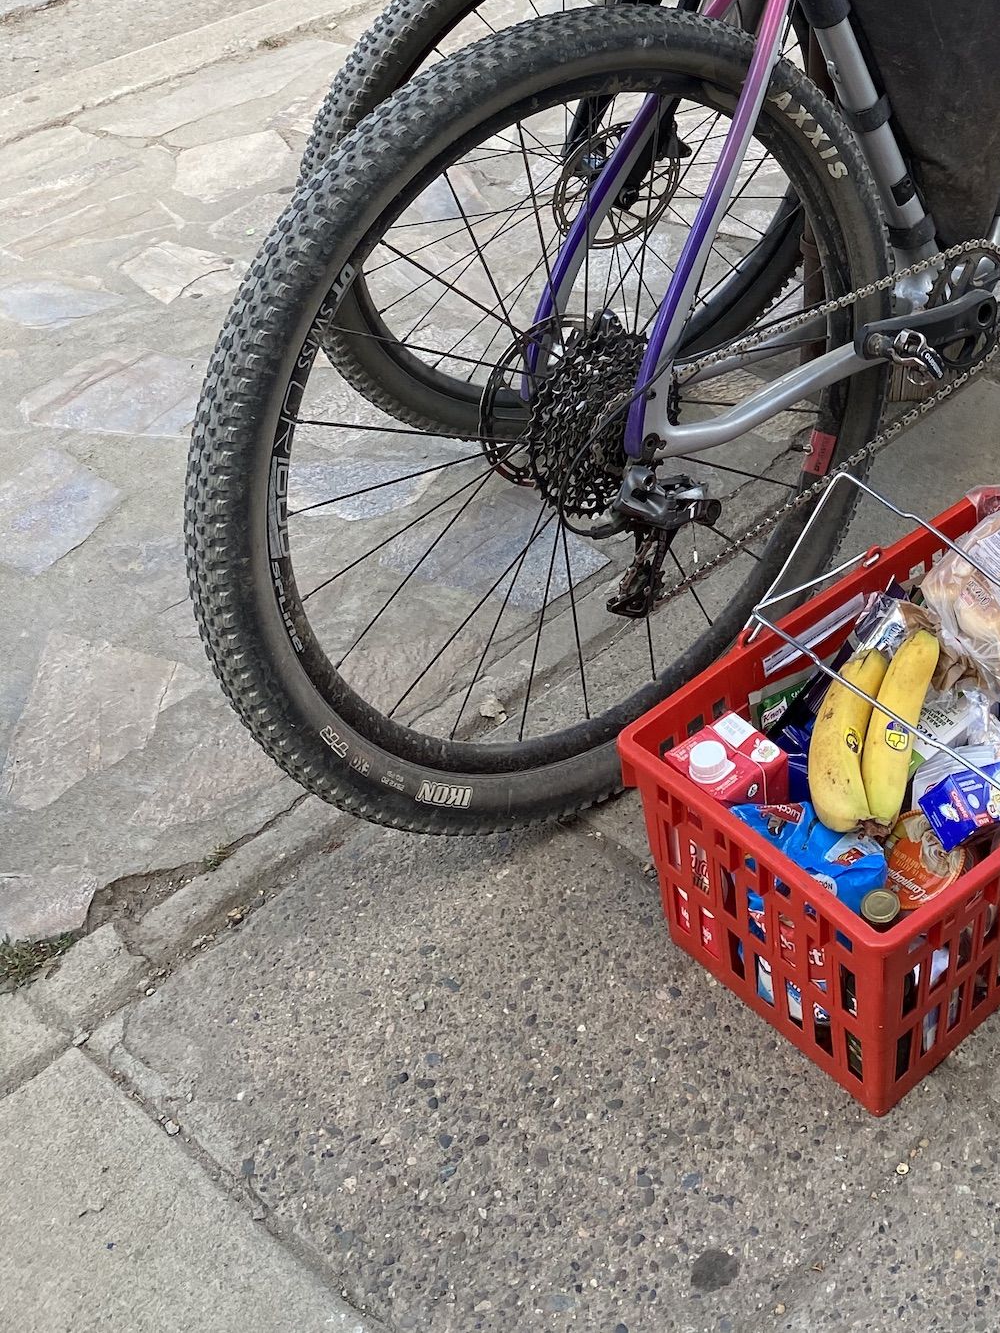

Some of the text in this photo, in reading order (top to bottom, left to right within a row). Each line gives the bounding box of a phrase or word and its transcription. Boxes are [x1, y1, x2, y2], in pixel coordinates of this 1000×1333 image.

[767, 91, 848, 179] AXXIS
[332, 262, 356, 302] DT
[298, 303, 333, 370] SWISS
[415, 779, 473, 810] IKON
